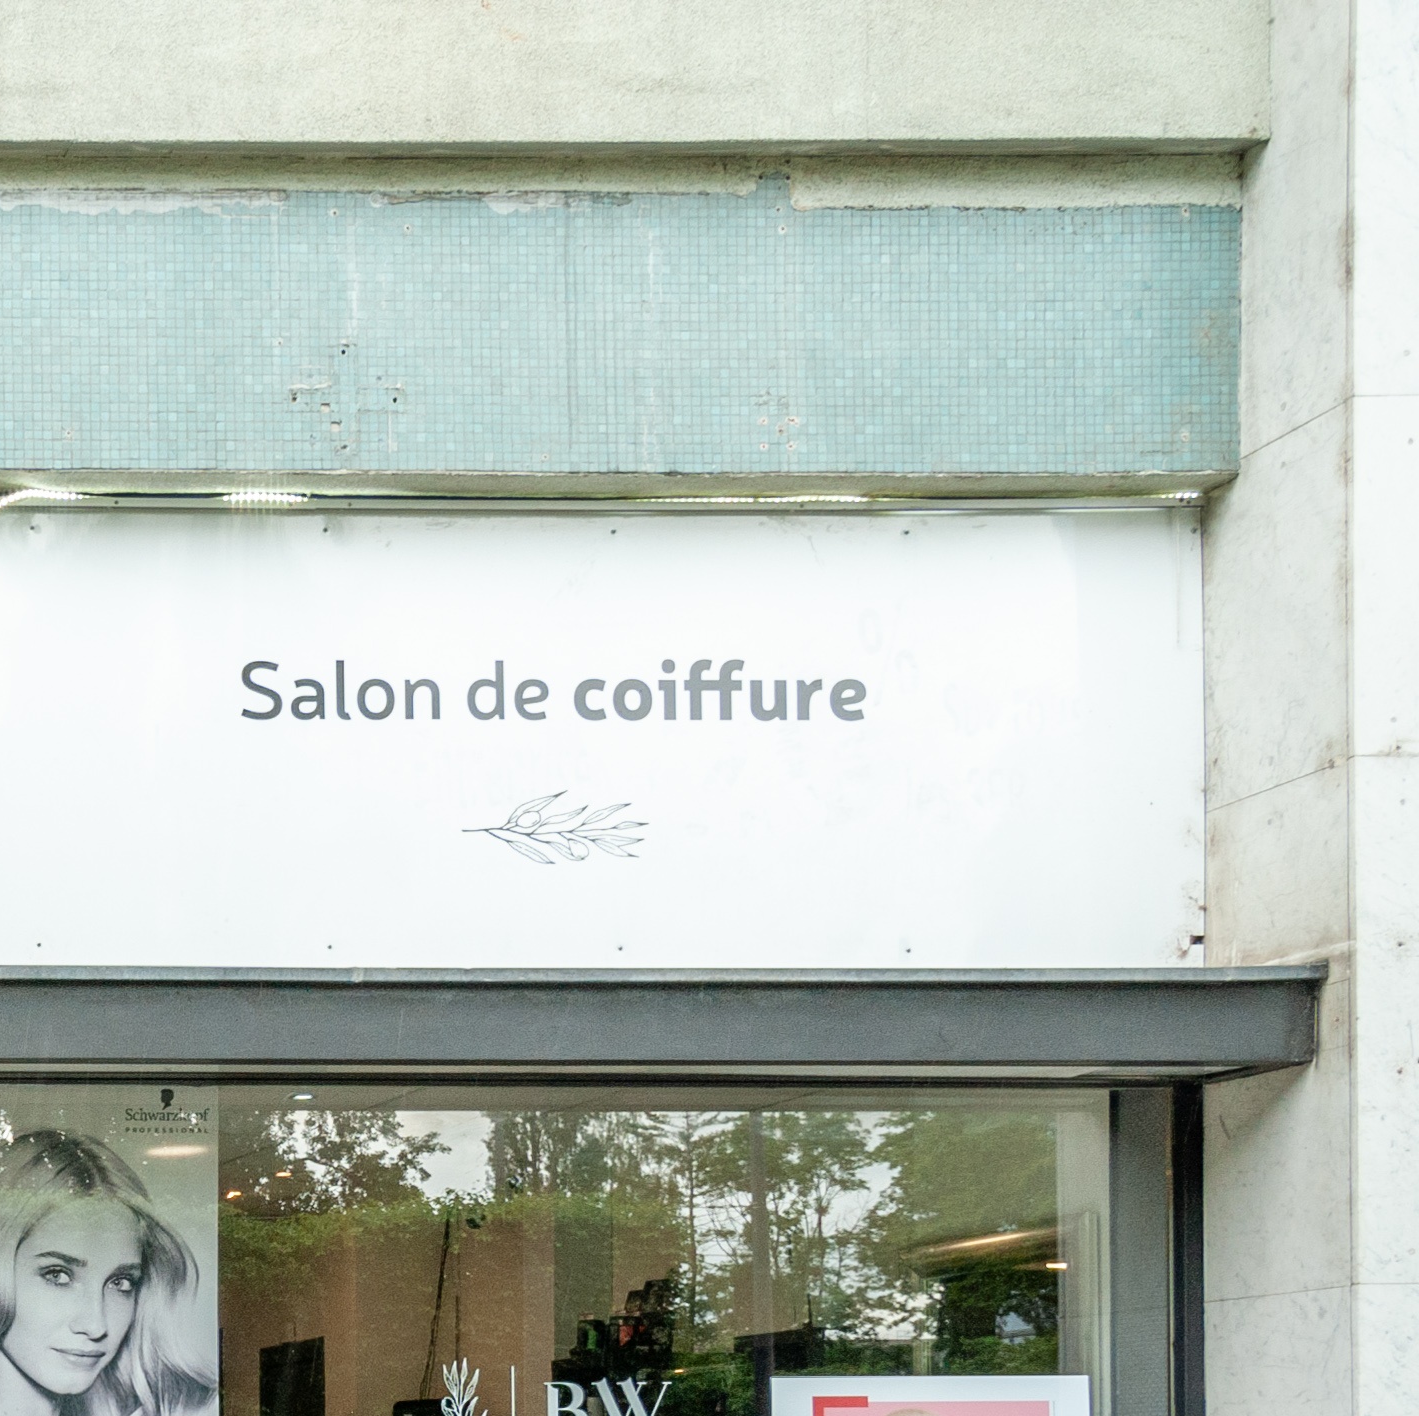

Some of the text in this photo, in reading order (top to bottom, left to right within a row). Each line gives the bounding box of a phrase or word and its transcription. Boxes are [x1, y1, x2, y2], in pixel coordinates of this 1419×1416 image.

[241, 659, 867, 721] Salon de coiffure
[125, 1126, 209, 1134] PROFESSIONAL
